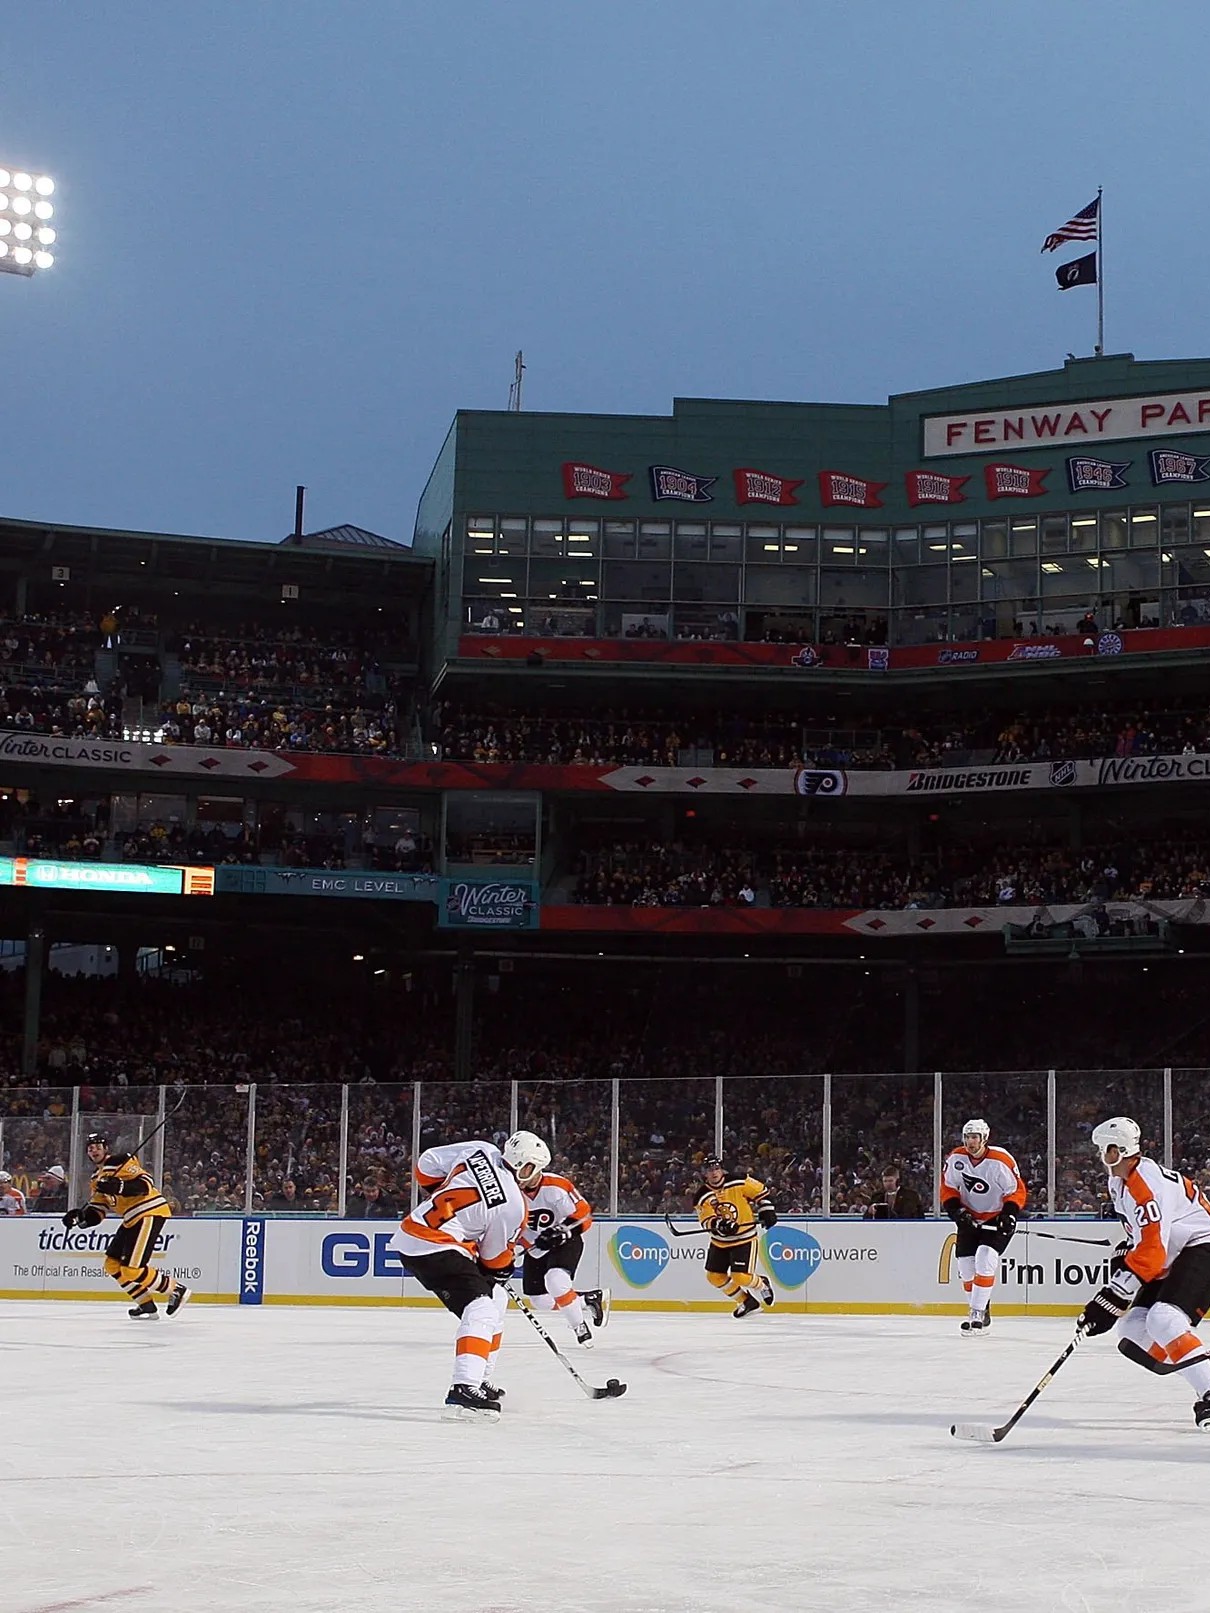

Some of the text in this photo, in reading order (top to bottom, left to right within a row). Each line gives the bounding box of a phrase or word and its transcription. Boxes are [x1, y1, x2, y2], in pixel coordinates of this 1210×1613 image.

[946, 407, 1113, 447] FENWAY
[1076, 465, 1112, 483] 1946
[1158, 457, 1197, 475] 1967
[573, 471, 612, 492] 1903
[996, 471, 1030, 489] 1918
[1161, 472, 1194, 480] CHAMPIONS
[575, 486, 609, 497] CHAMPIONS
[659, 475, 698, 496] 1904
[662, 489, 695, 500] CHAMPIONS
[747, 477, 782, 498] 1912
[831, 480, 867, 499] 1915
[916, 479, 950, 497] 1916
[997, 486, 1029, 494] CHAMPIONS
[747, 492, 780, 502] CHAMPIONS
[832, 495, 865, 505] CHAMPIONS
[917, 493, 949, 501] CHAMPIONS
[952, 650, 978, 660] RADIO
[52, 746, 133, 763] CLASSIC
[906, 769, 1033, 791] BRIDGESTONE
[59, 867, 154, 885] HONDA
[311, 878, 404, 894] EMC LEVEL
[454, 883, 529, 916] Winter
[468, 904, 524, 917] CLASSIC
[1134, 1199, 1162, 1228] 20
[38, 1226, 175, 1251] ticketmer
[244, 1221, 260, 1293] Reebok
[618, 1240, 706, 1266] Compuwa
[768, 1240, 878, 1266] Compuware
[13, 1264, 30, 1277] The
[62, 1265, 79, 1278] Fan
[1001, 1258, 1110, 1285] i'm lovi
